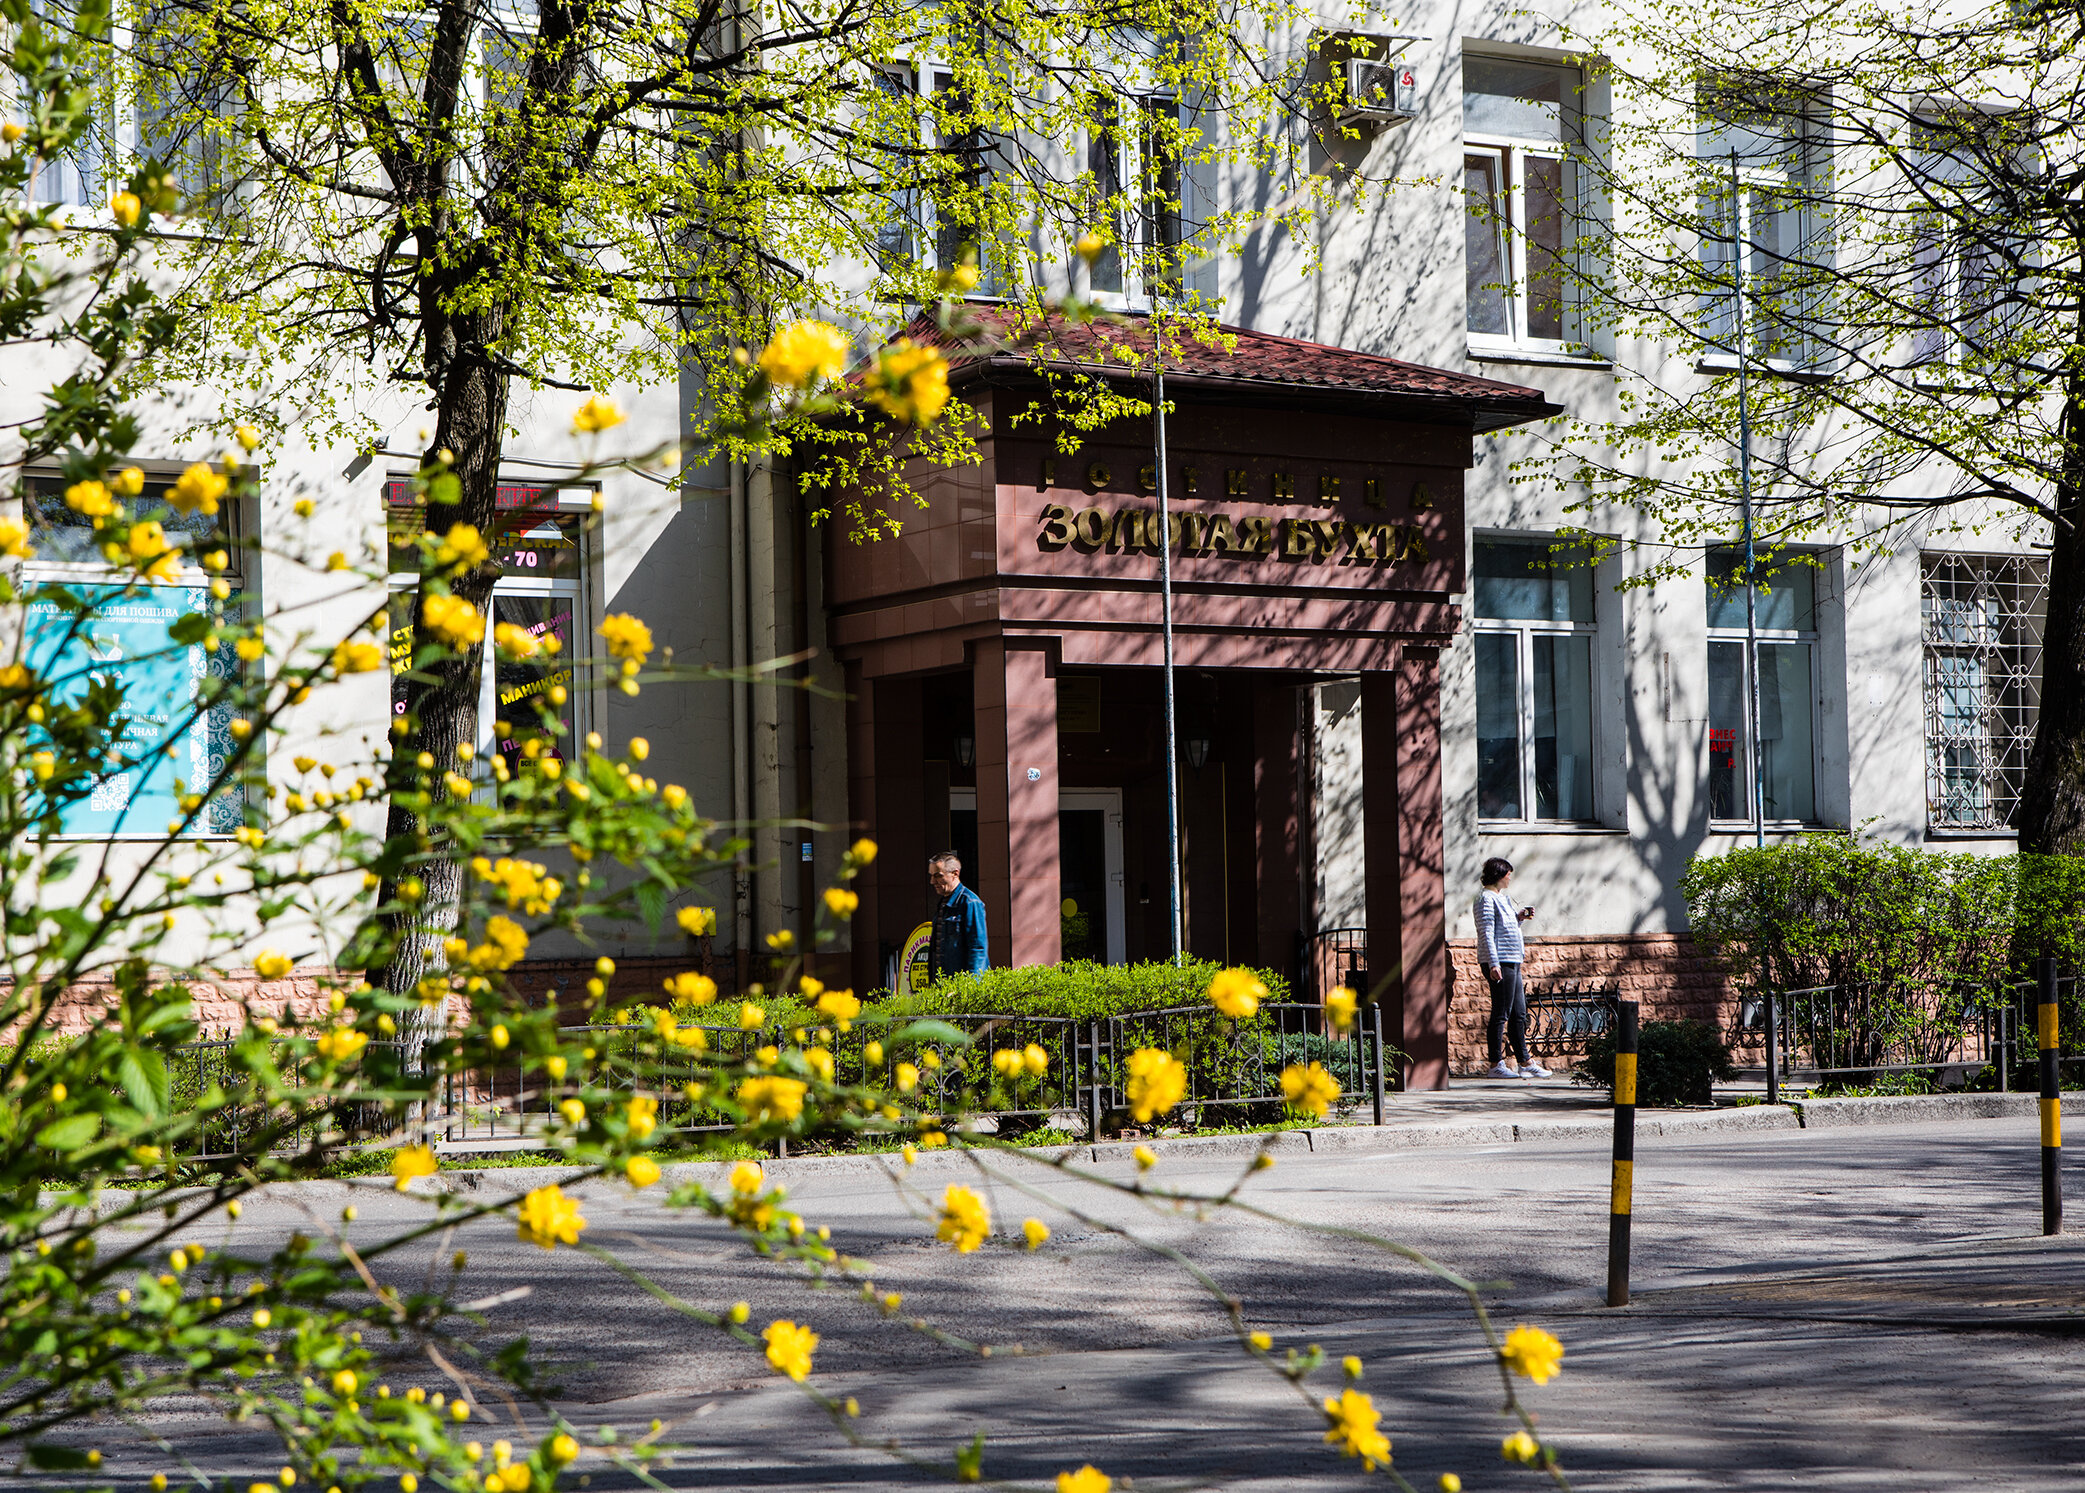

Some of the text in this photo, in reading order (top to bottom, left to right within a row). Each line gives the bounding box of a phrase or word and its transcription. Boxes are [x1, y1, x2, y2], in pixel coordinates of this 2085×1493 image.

[1044, 459, 1433, 508] ГОСТИНИЦА
[1044, 504, 1431, 563] ЗОЛОТАЯ БУХТА
[103, 605, 127, 617] ДЛЯ
[129, 606, 179, 618] ПОШИВА
[500, 668, 572, 706] МАНИКЮР
[1709, 728, 1736, 740] ЗНЕС
[1710, 741, 1733, 752] АНЧ
